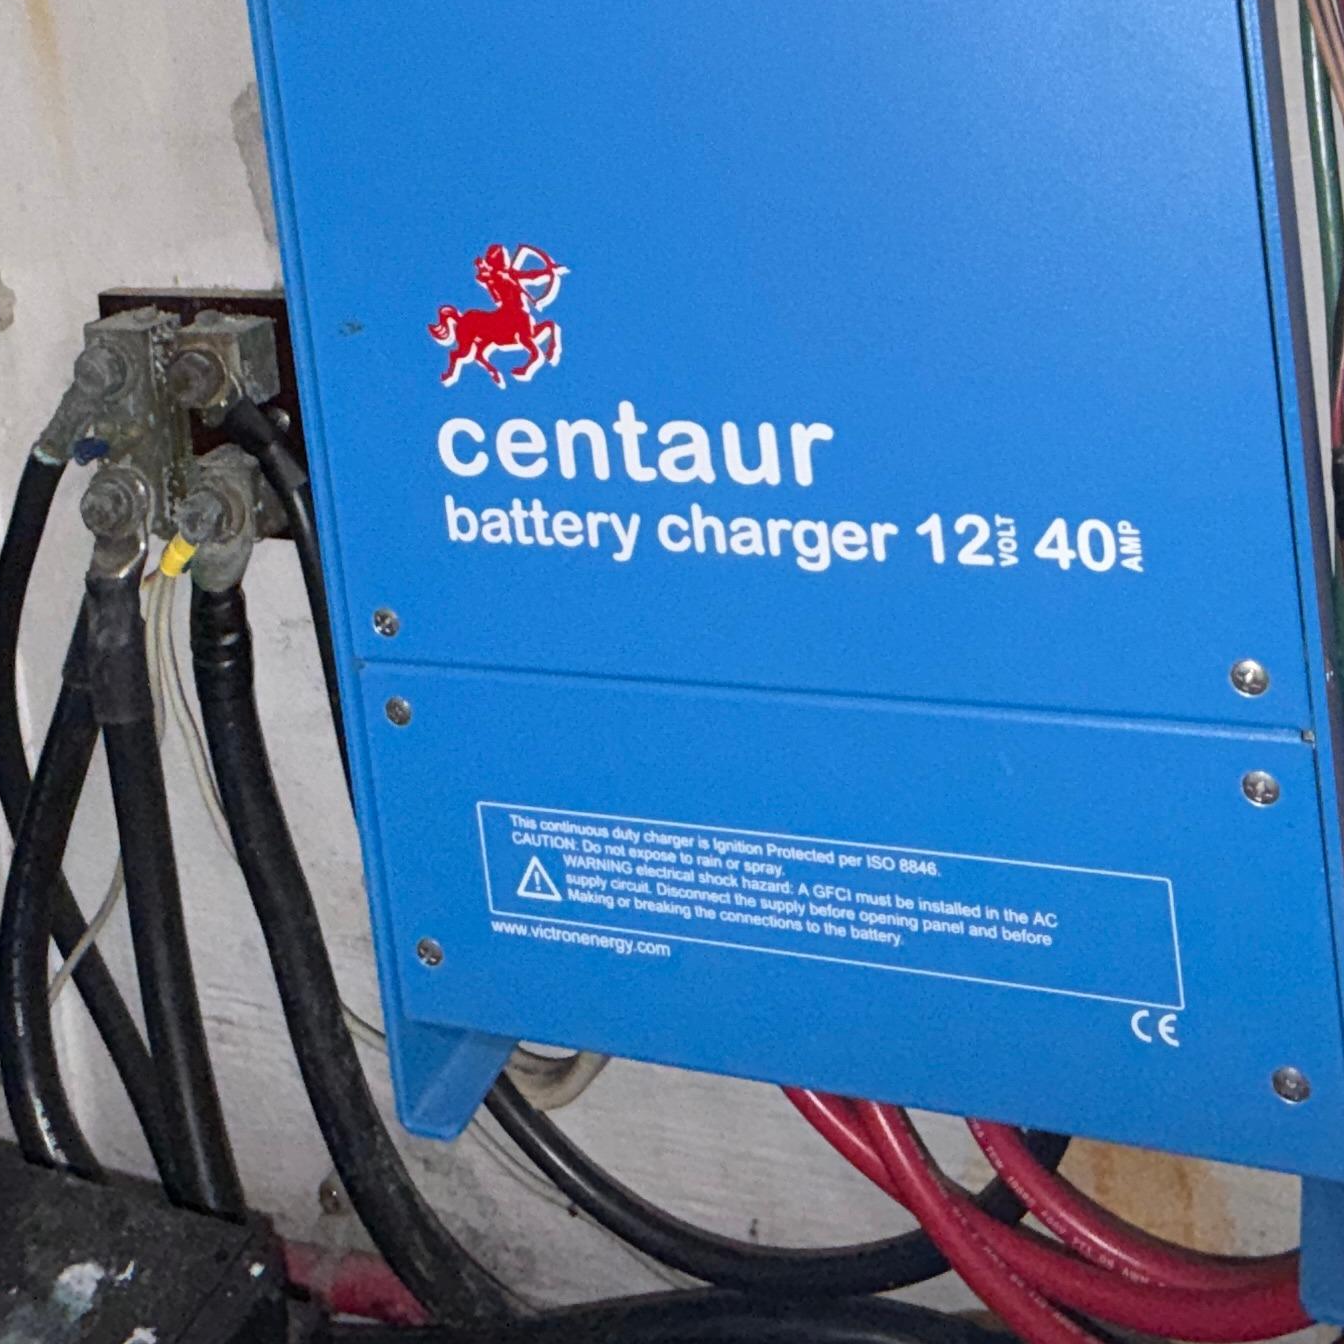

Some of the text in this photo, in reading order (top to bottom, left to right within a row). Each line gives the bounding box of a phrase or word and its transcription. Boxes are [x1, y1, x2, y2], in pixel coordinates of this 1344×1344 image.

[437, 400, 834, 486] centaur
[444, 494, 1146, 572] battery charger 12 VOLT 40 AMP
[510, 816, 942, 876] This continuous duty charger is Ignition Protected per ISO 8846.
[512, 831, 786, 878] CAUTION: Do not expose to rain or spray.
[563, 854, 1058, 928] WARNING electrical shock hazard: A GFCI must be installed in the AC
[565, 873, 1052, 946] supply circuit. Disconnect the supply before opening panel and before
[567, 888, 904, 946] Making or breaking the connections to the battery.
[491, 921, 671, 956] www.victronenergy.com
[1131, 1009, 1181, 1047] CE
